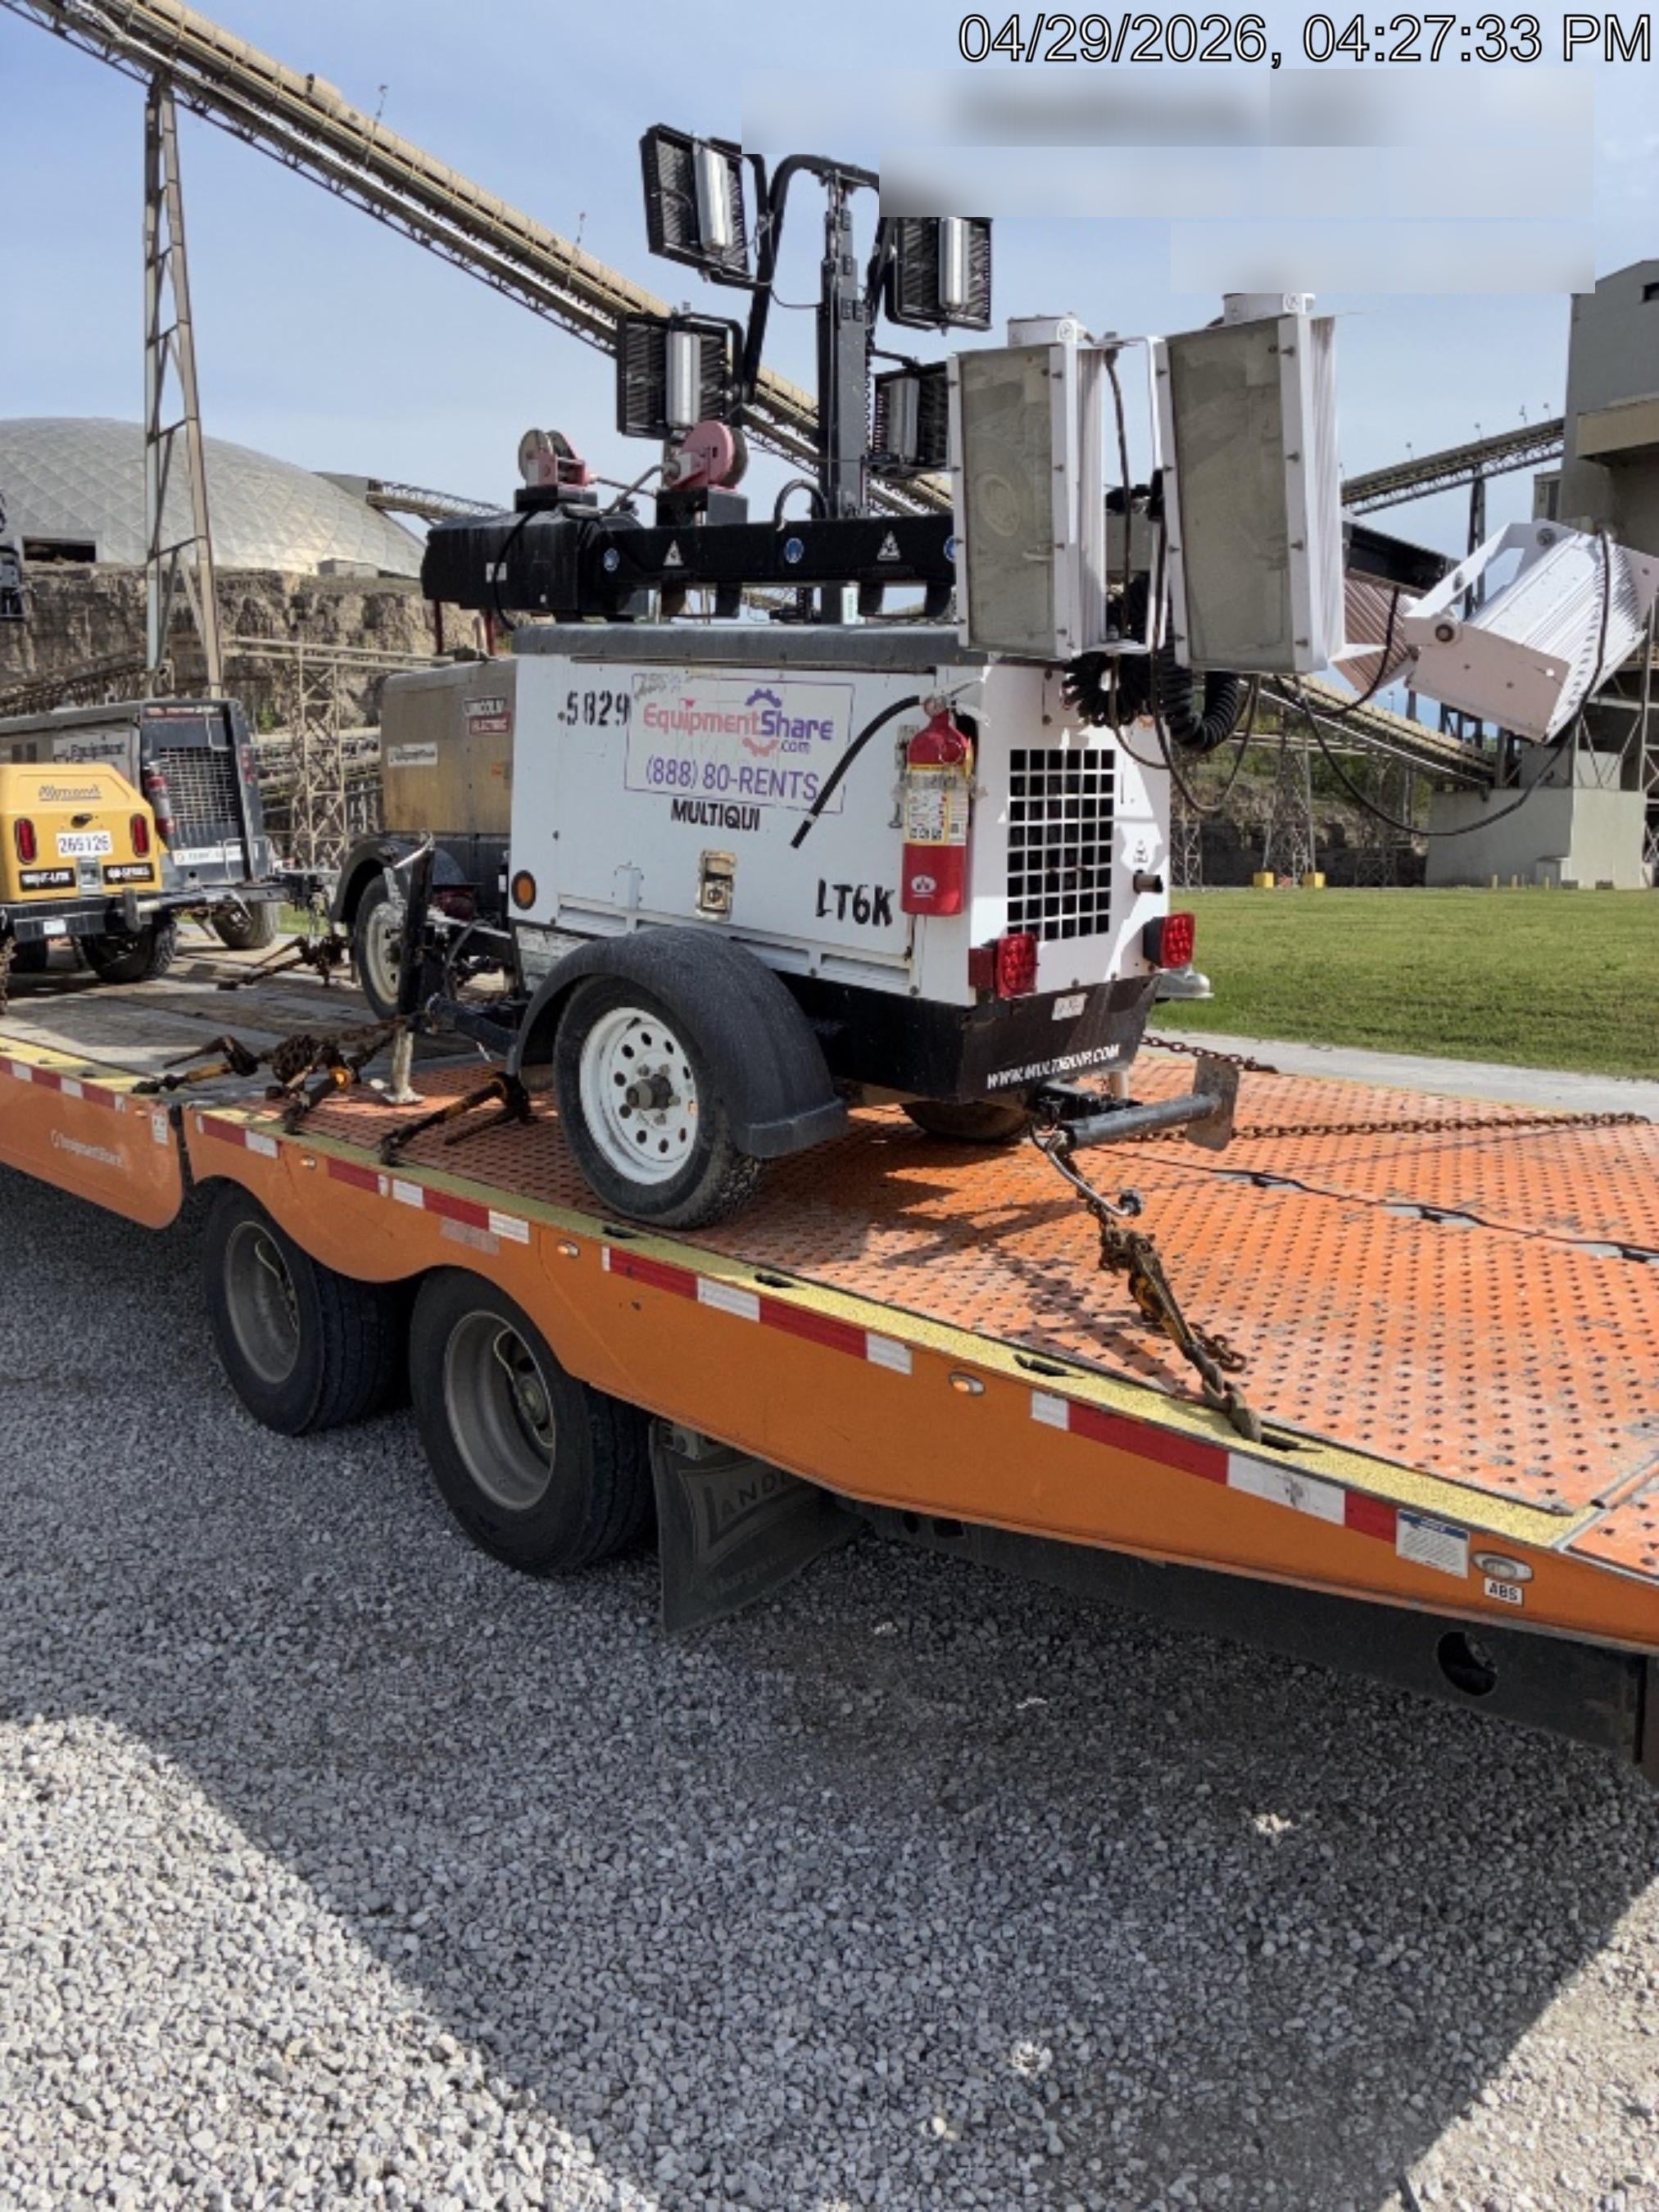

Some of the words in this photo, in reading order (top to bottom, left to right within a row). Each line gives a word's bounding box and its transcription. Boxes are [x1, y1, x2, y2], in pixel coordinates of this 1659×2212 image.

[646, 755, 696, 790] (888)
[702, 763, 819, 801] 80-RENTS
[815, 878, 895, 927] LT6K
[1489, 1581, 1518, 1601] ABS
